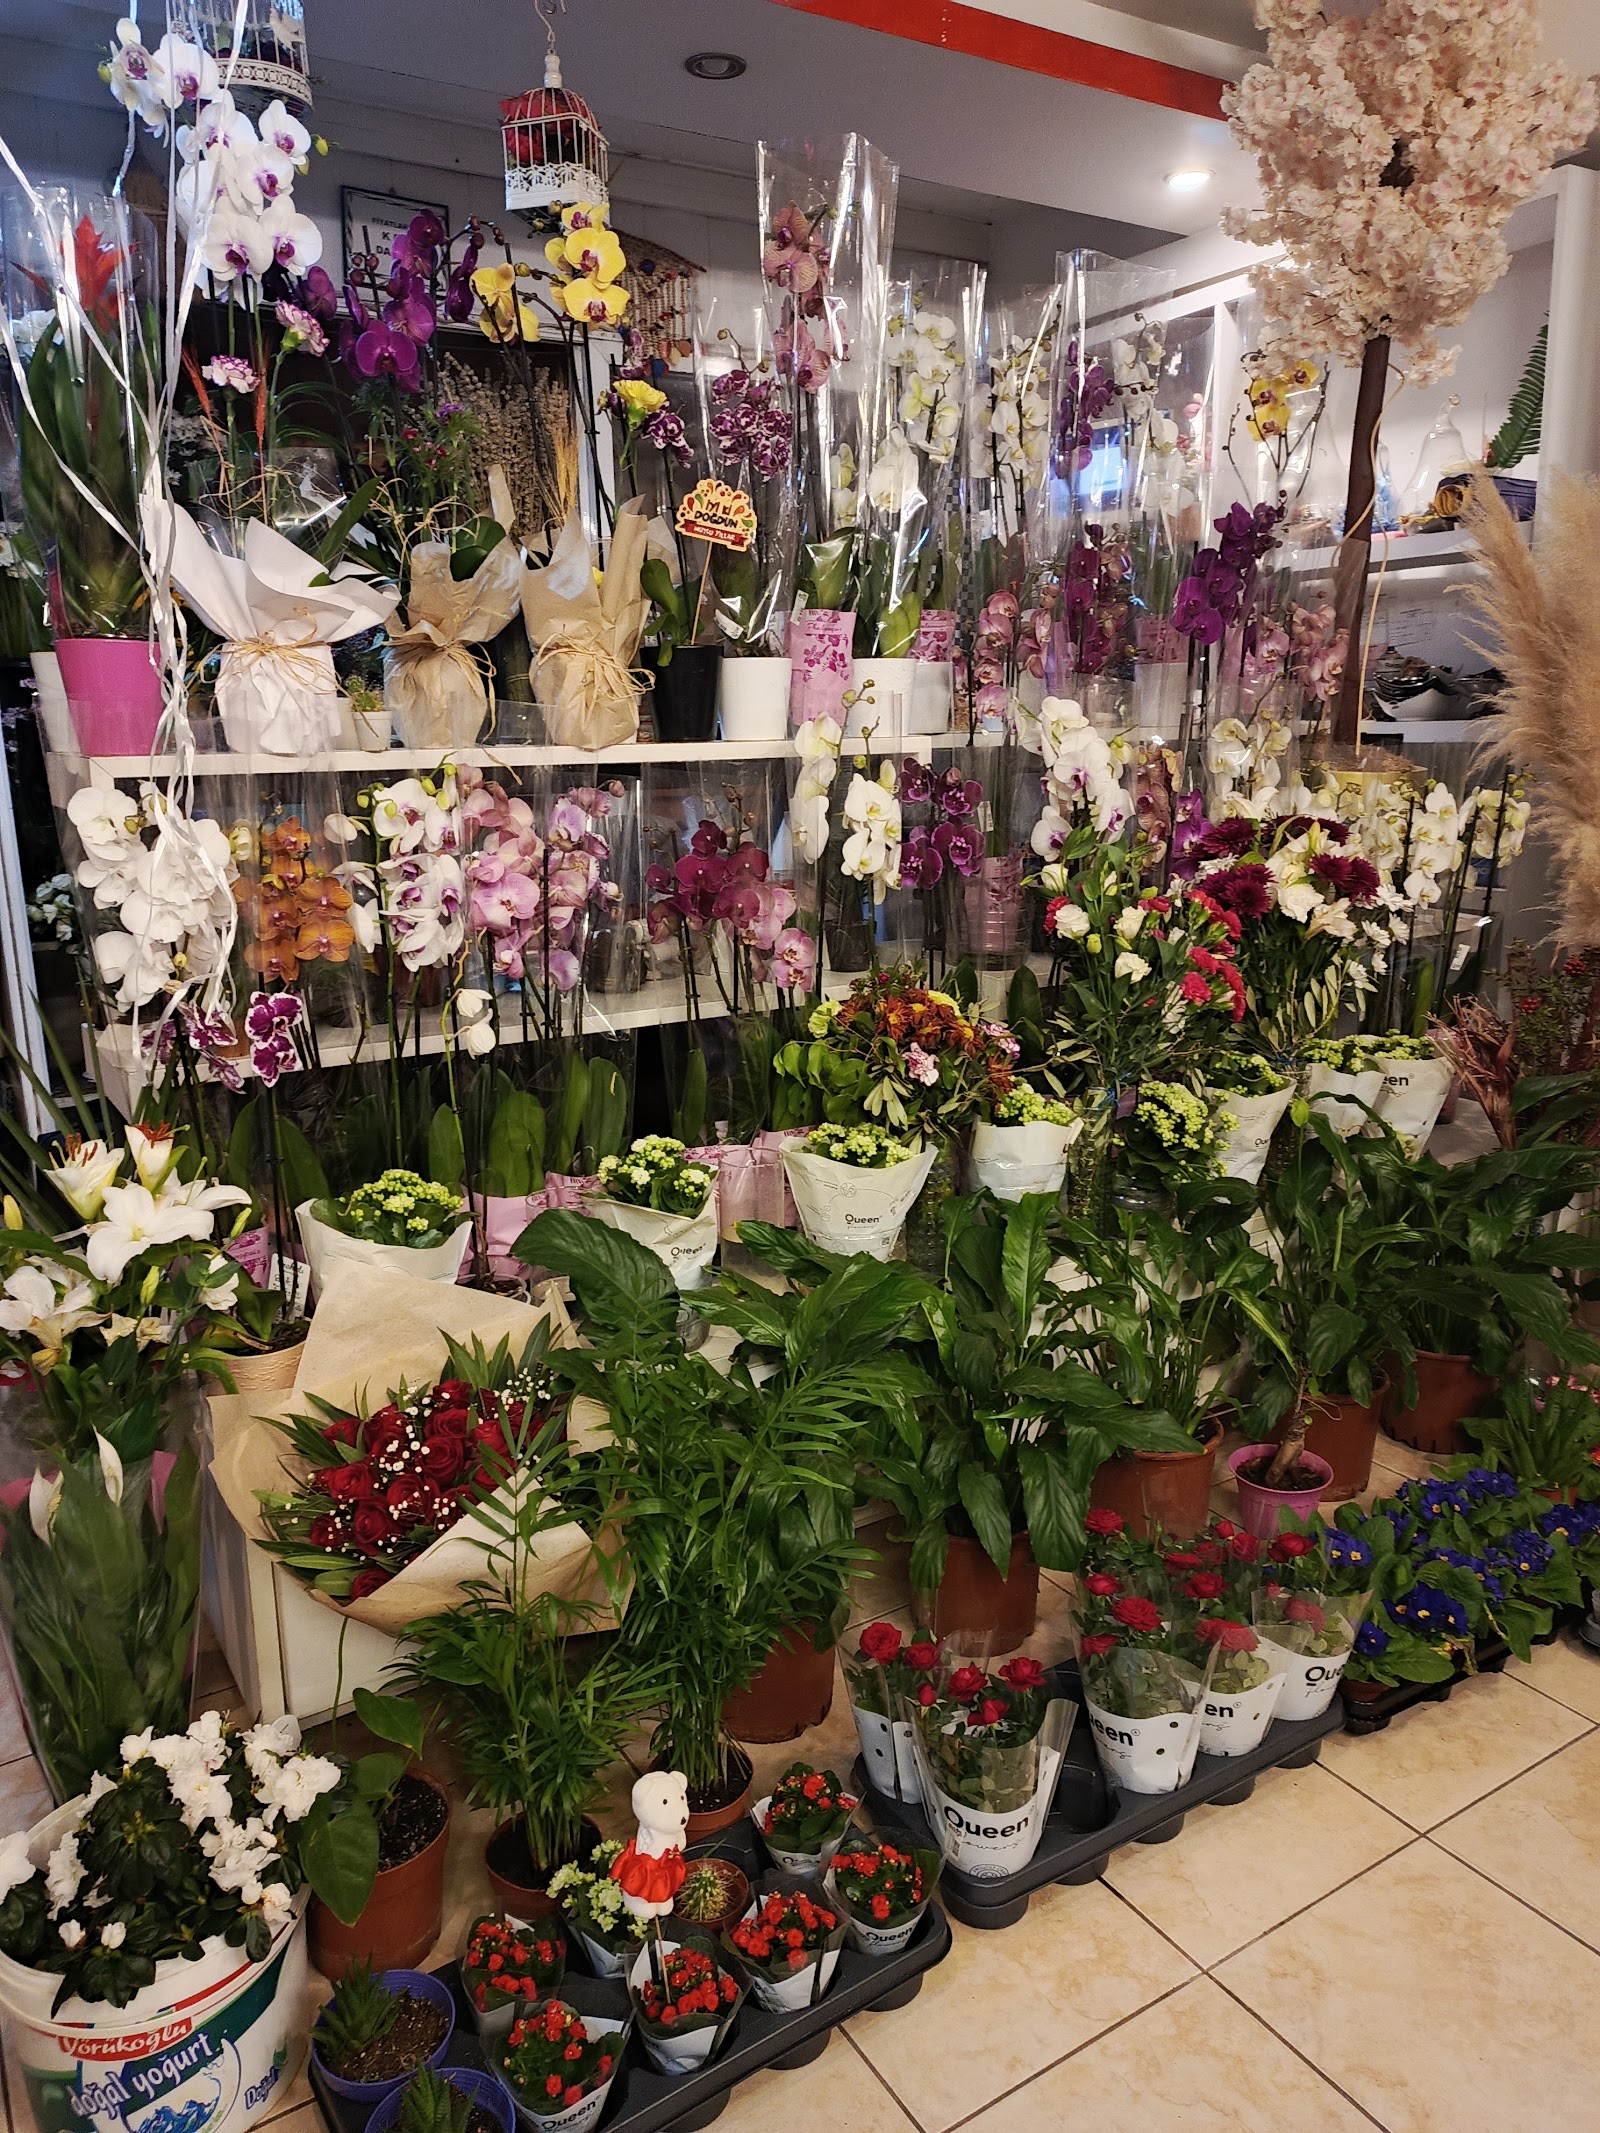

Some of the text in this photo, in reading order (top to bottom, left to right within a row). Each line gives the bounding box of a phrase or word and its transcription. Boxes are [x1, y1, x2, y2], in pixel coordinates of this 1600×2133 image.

[844, 1213, 880, 1225] Queen
[944, 1805, 1029, 1839] Queen
[865, 1927, 914, 1942] Queen
[61, 2022, 189, 2056] Yörükoğlu
[66, 2031, 214, 2120] doğal yoğurt
[541, 2100, 597, 2130] Queen
